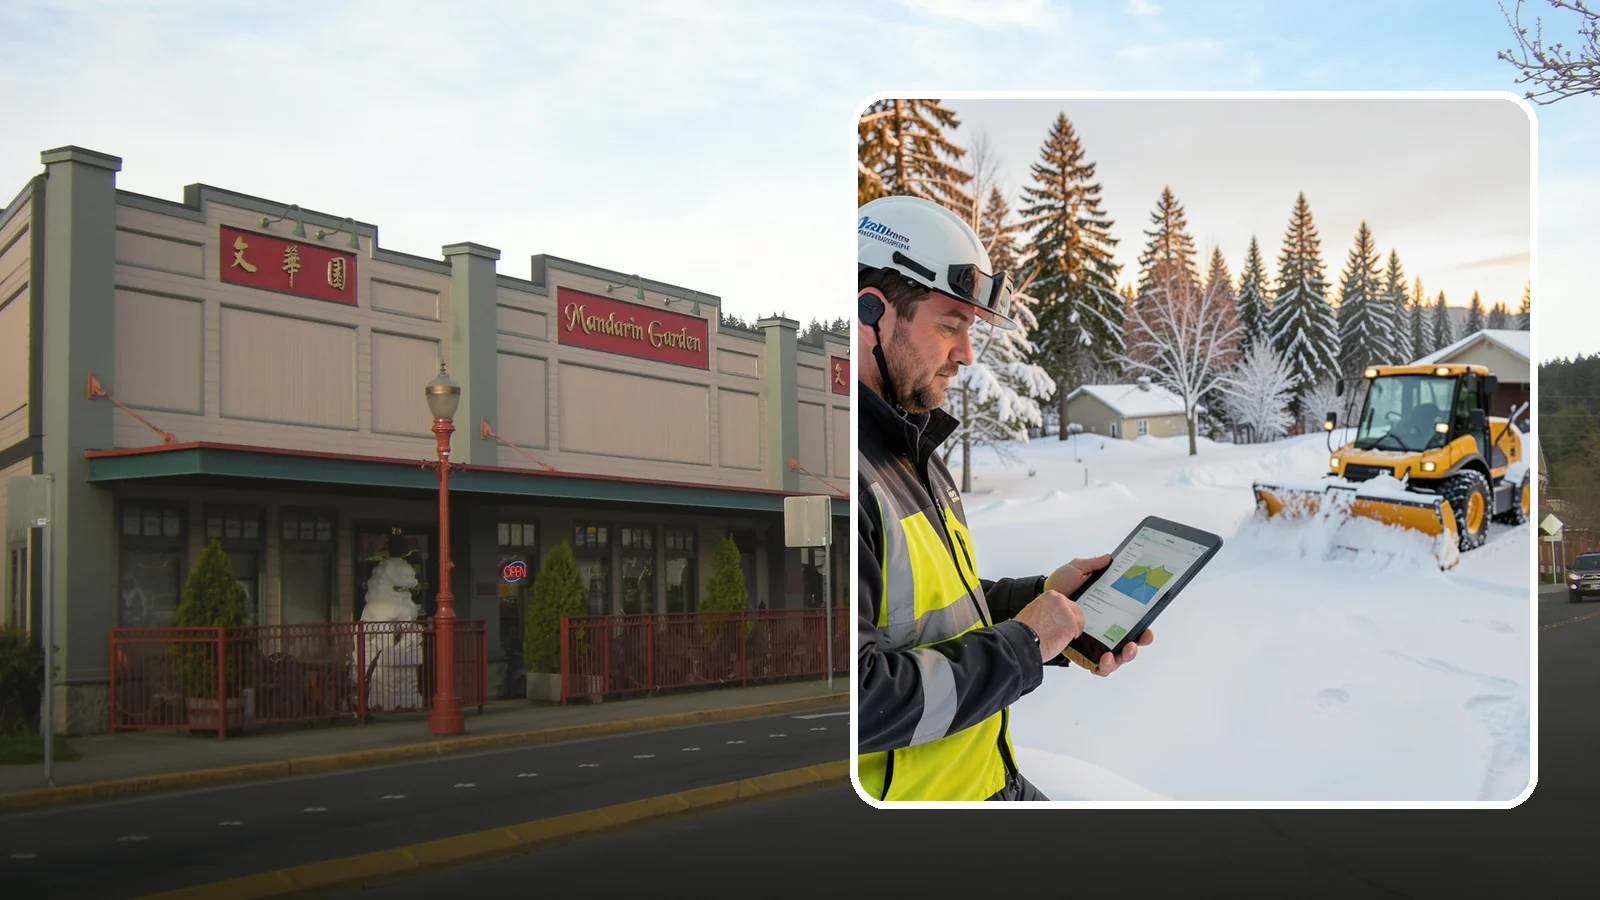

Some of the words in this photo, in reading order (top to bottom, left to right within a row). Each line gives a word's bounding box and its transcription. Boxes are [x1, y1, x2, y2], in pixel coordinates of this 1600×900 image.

[231, 235, 346, 291] 文華園
[564, 302, 644, 341] Mandarin
[648, 320, 702, 352] Garden
[503, 565, 527, 578] OPEN
